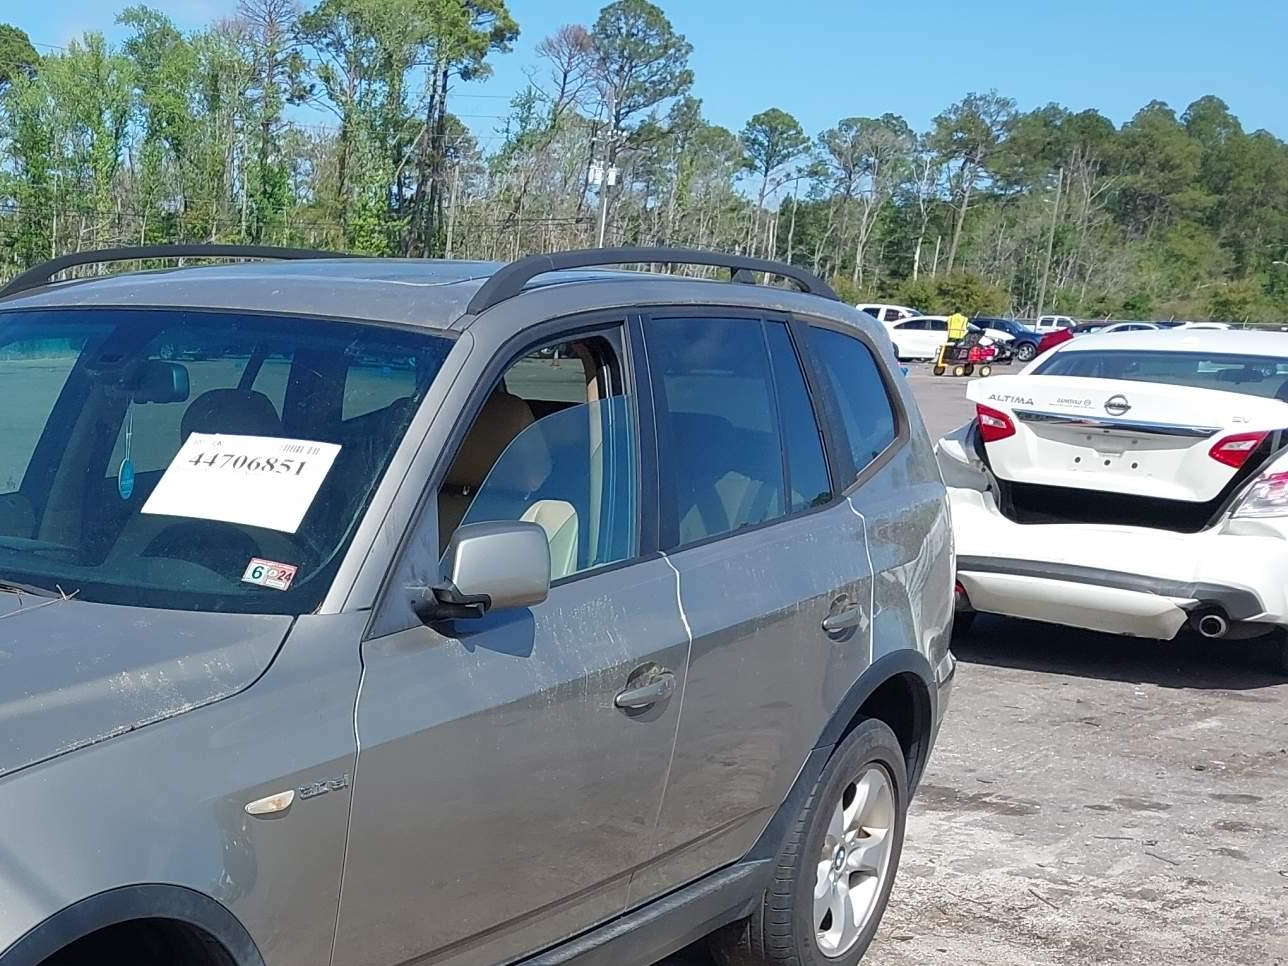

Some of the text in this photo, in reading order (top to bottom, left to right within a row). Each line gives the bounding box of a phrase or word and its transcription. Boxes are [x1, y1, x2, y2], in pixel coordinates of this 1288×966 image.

[988, 393, 1034, 406] ALTIMA
[189, 452, 307, 476] 44706851
[252, 565, 292, 582] 6 24
